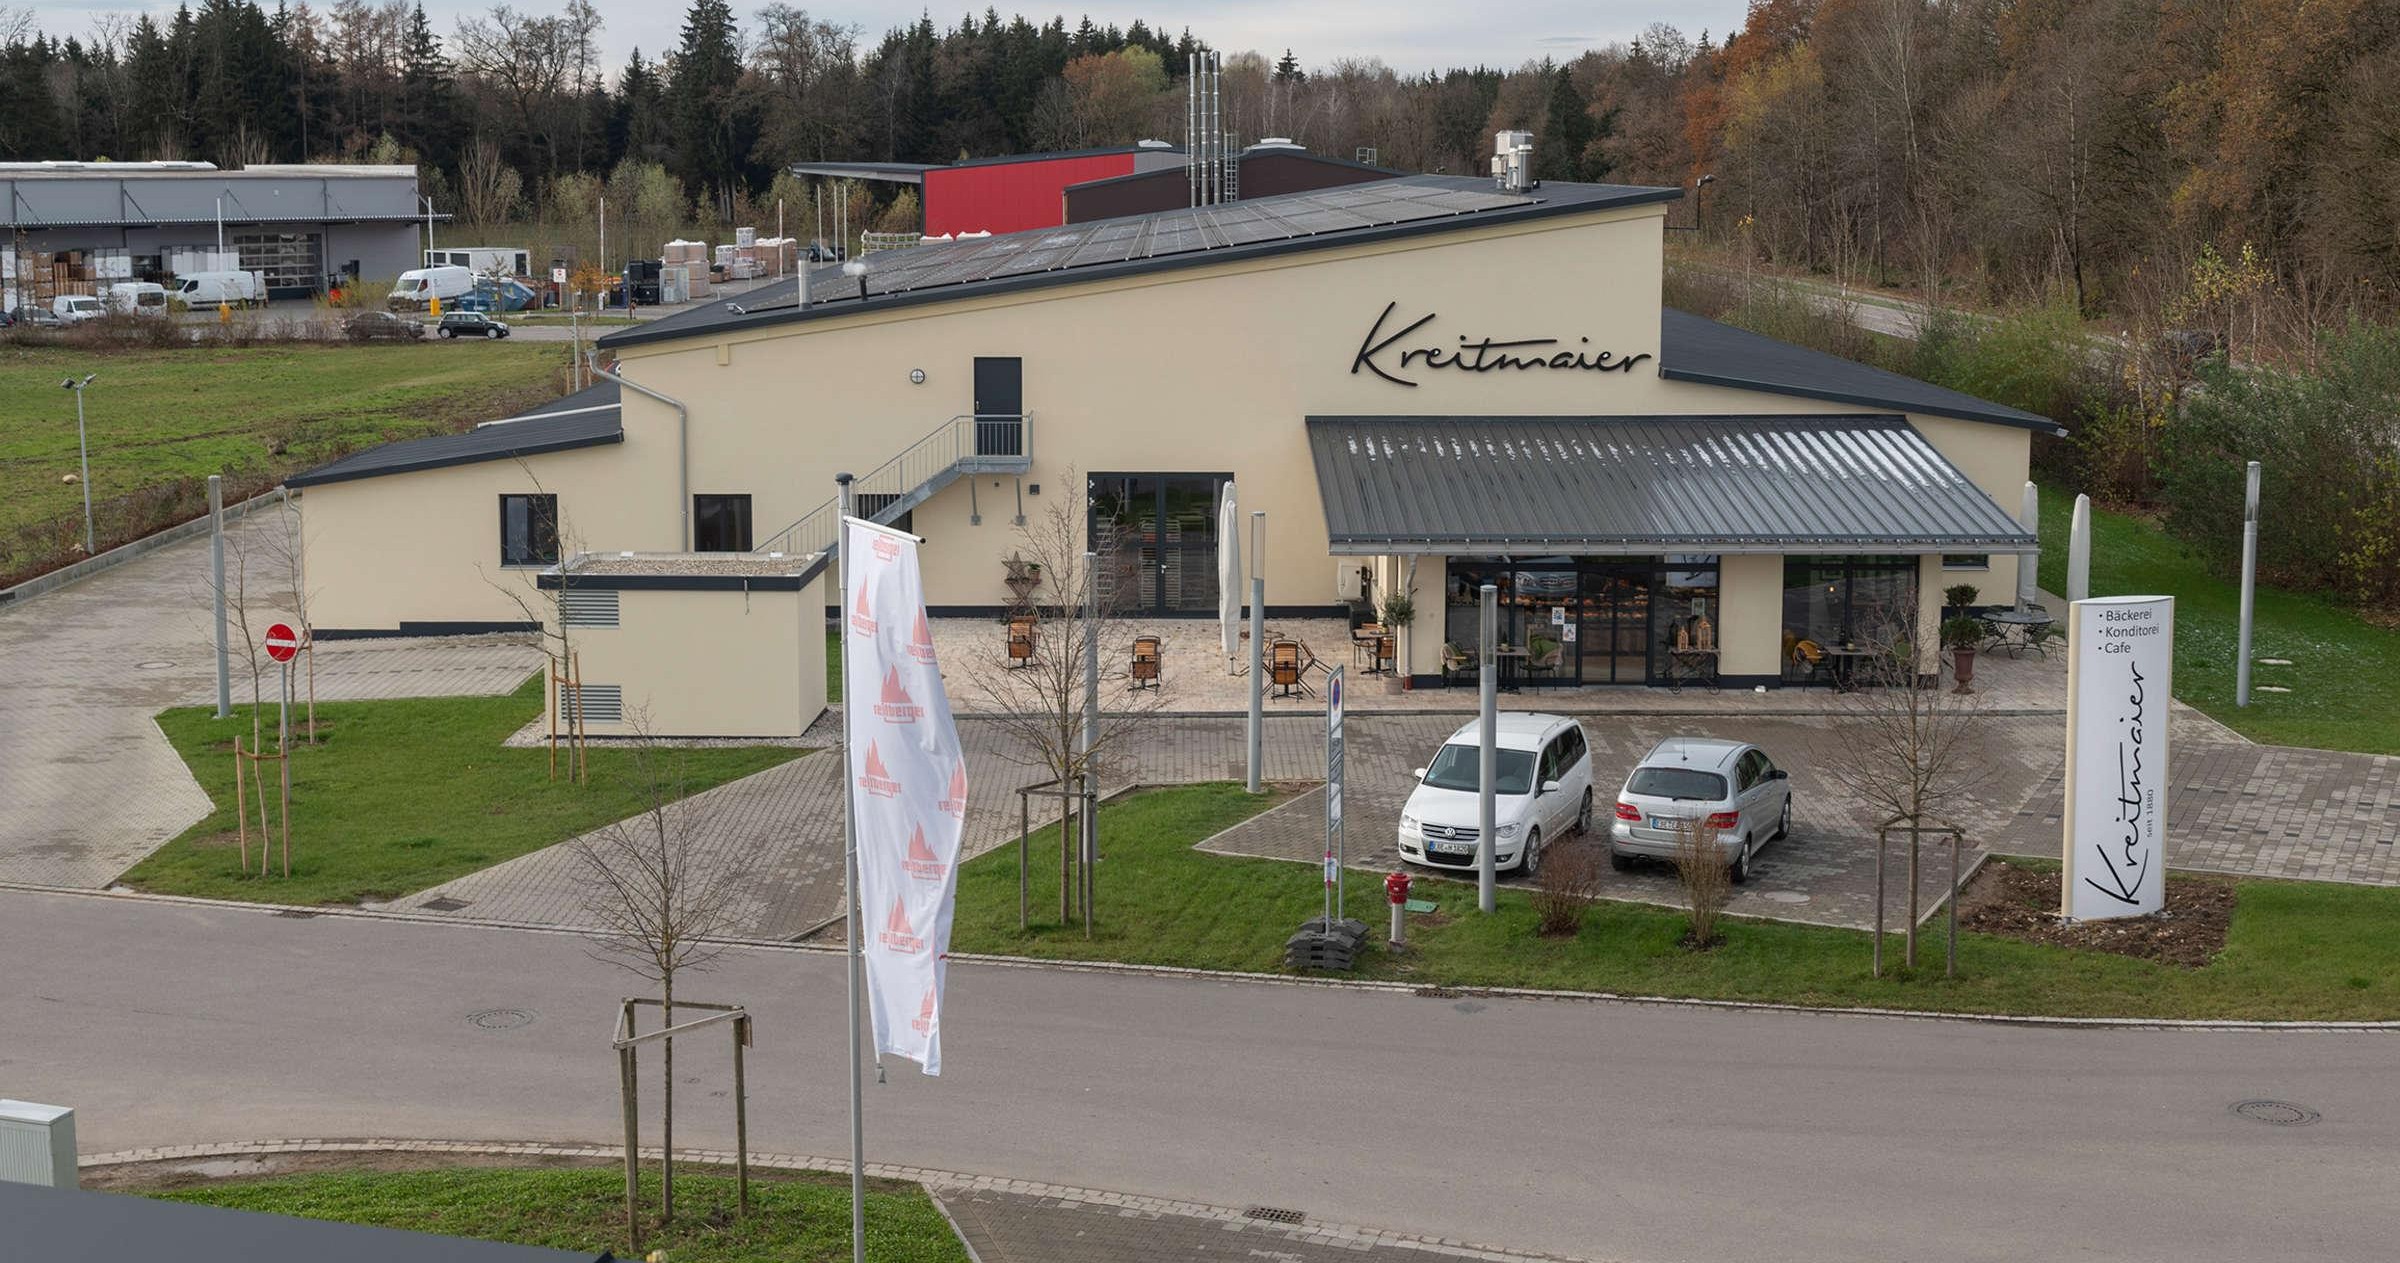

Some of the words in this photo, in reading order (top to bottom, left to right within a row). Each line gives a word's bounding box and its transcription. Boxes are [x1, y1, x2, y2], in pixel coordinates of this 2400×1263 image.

[1350, 301, 1652, 387] Kreitmaier
[2106, 608, 2153, 622] Bäckerei
[2105, 623, 2160, 638] Konditorei
[2104, 641, 2132, 654] Cafe
[2085, 661, 2148, 905] Kreitmaier
[2145, 789, 2154, 815] 1880
